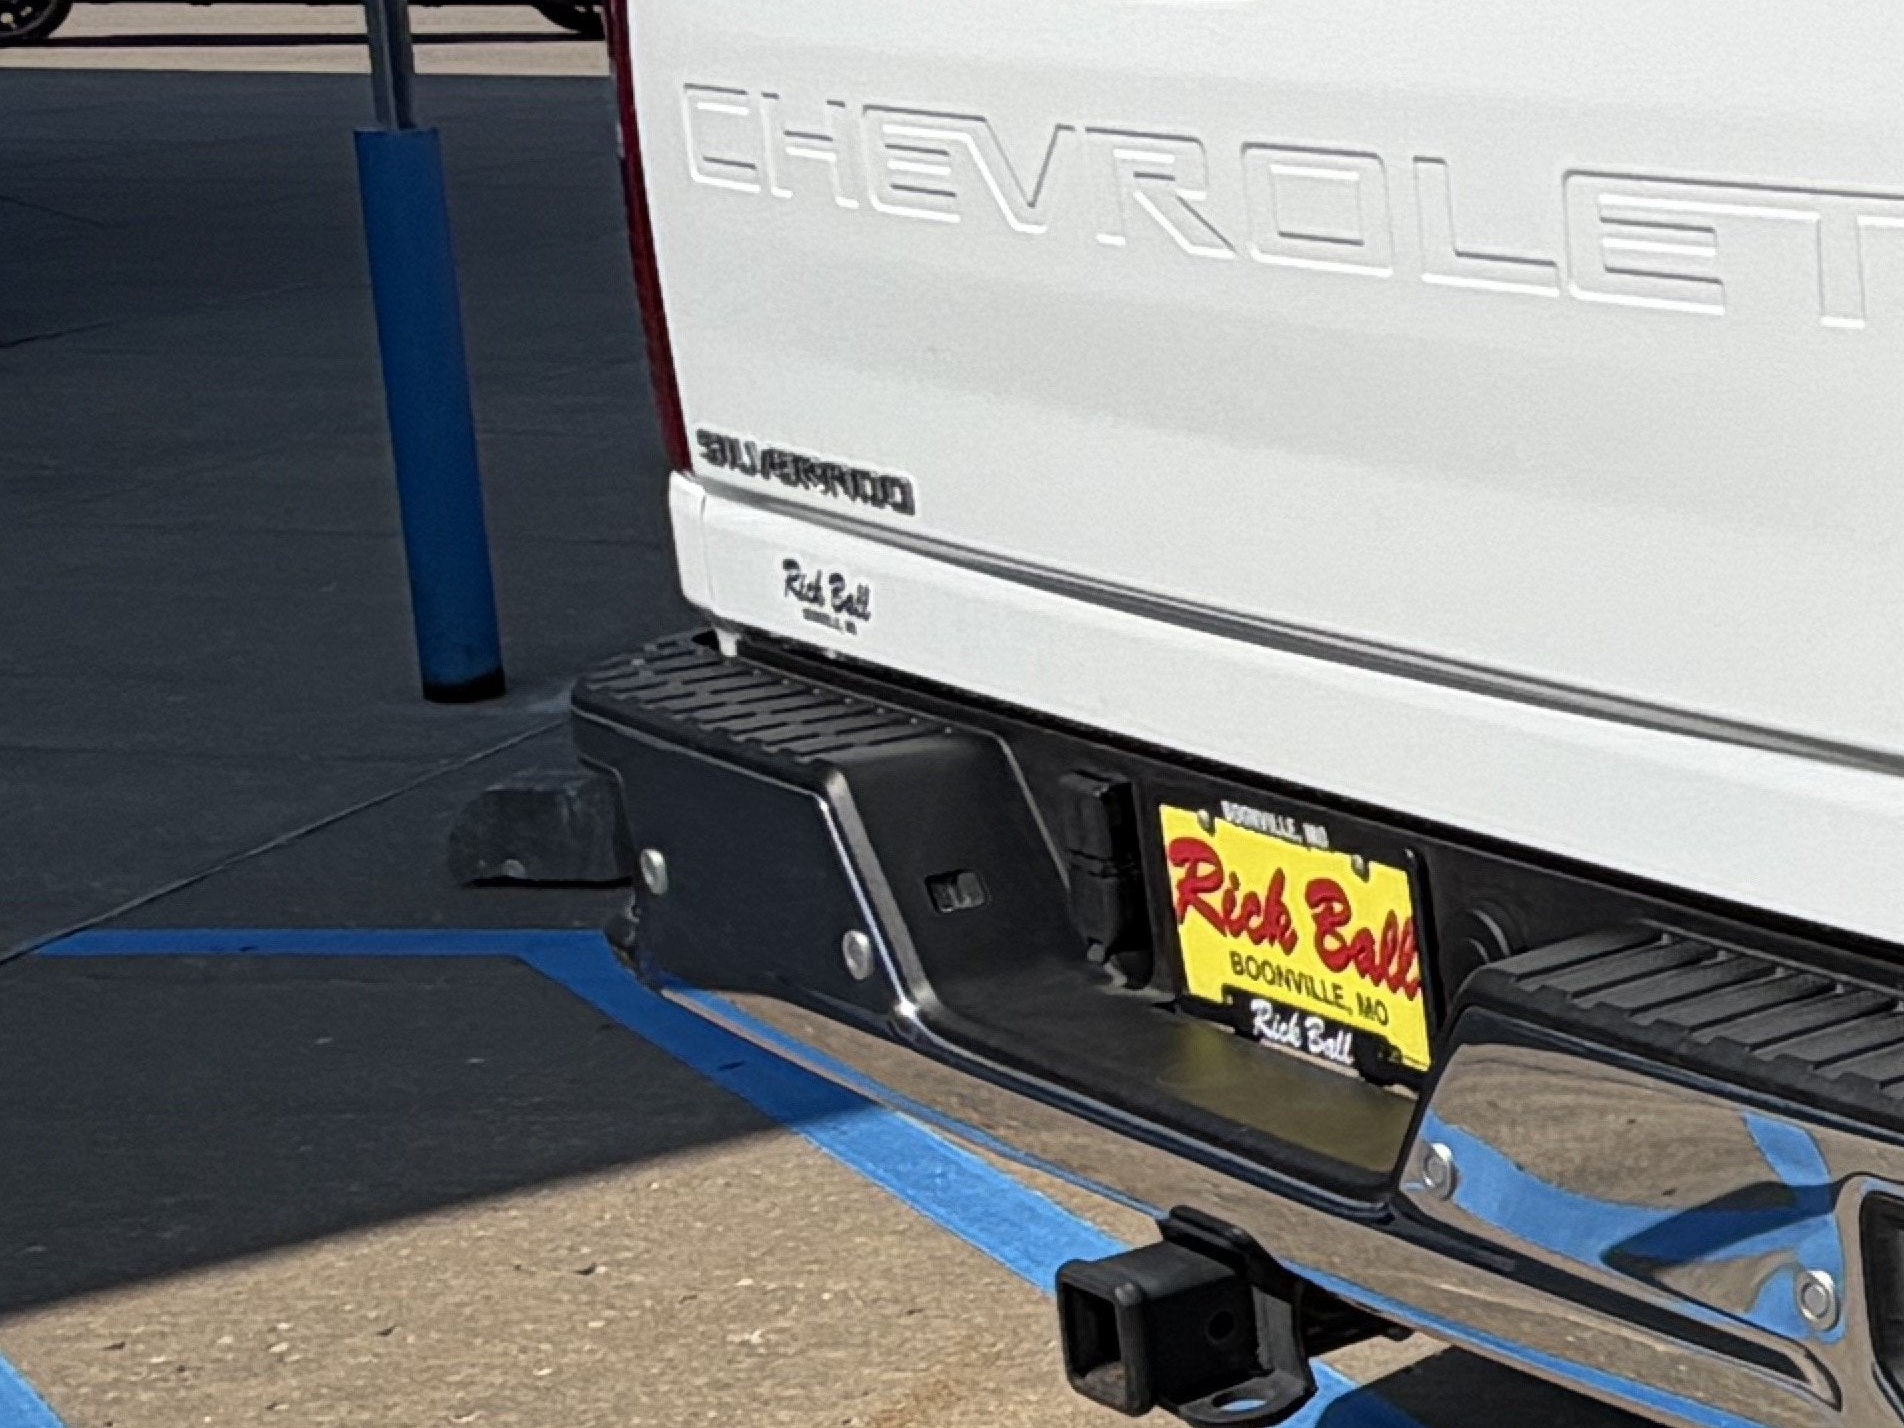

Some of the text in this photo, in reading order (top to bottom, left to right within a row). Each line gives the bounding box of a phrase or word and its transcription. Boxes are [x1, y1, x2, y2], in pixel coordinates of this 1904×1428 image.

[1168, 837, 1425, 1002] Rick Ball
[1229, 950, 1390, 1027] BOONVILLE, MO
[1250, 998, 1357, 1065] Rick Ball
